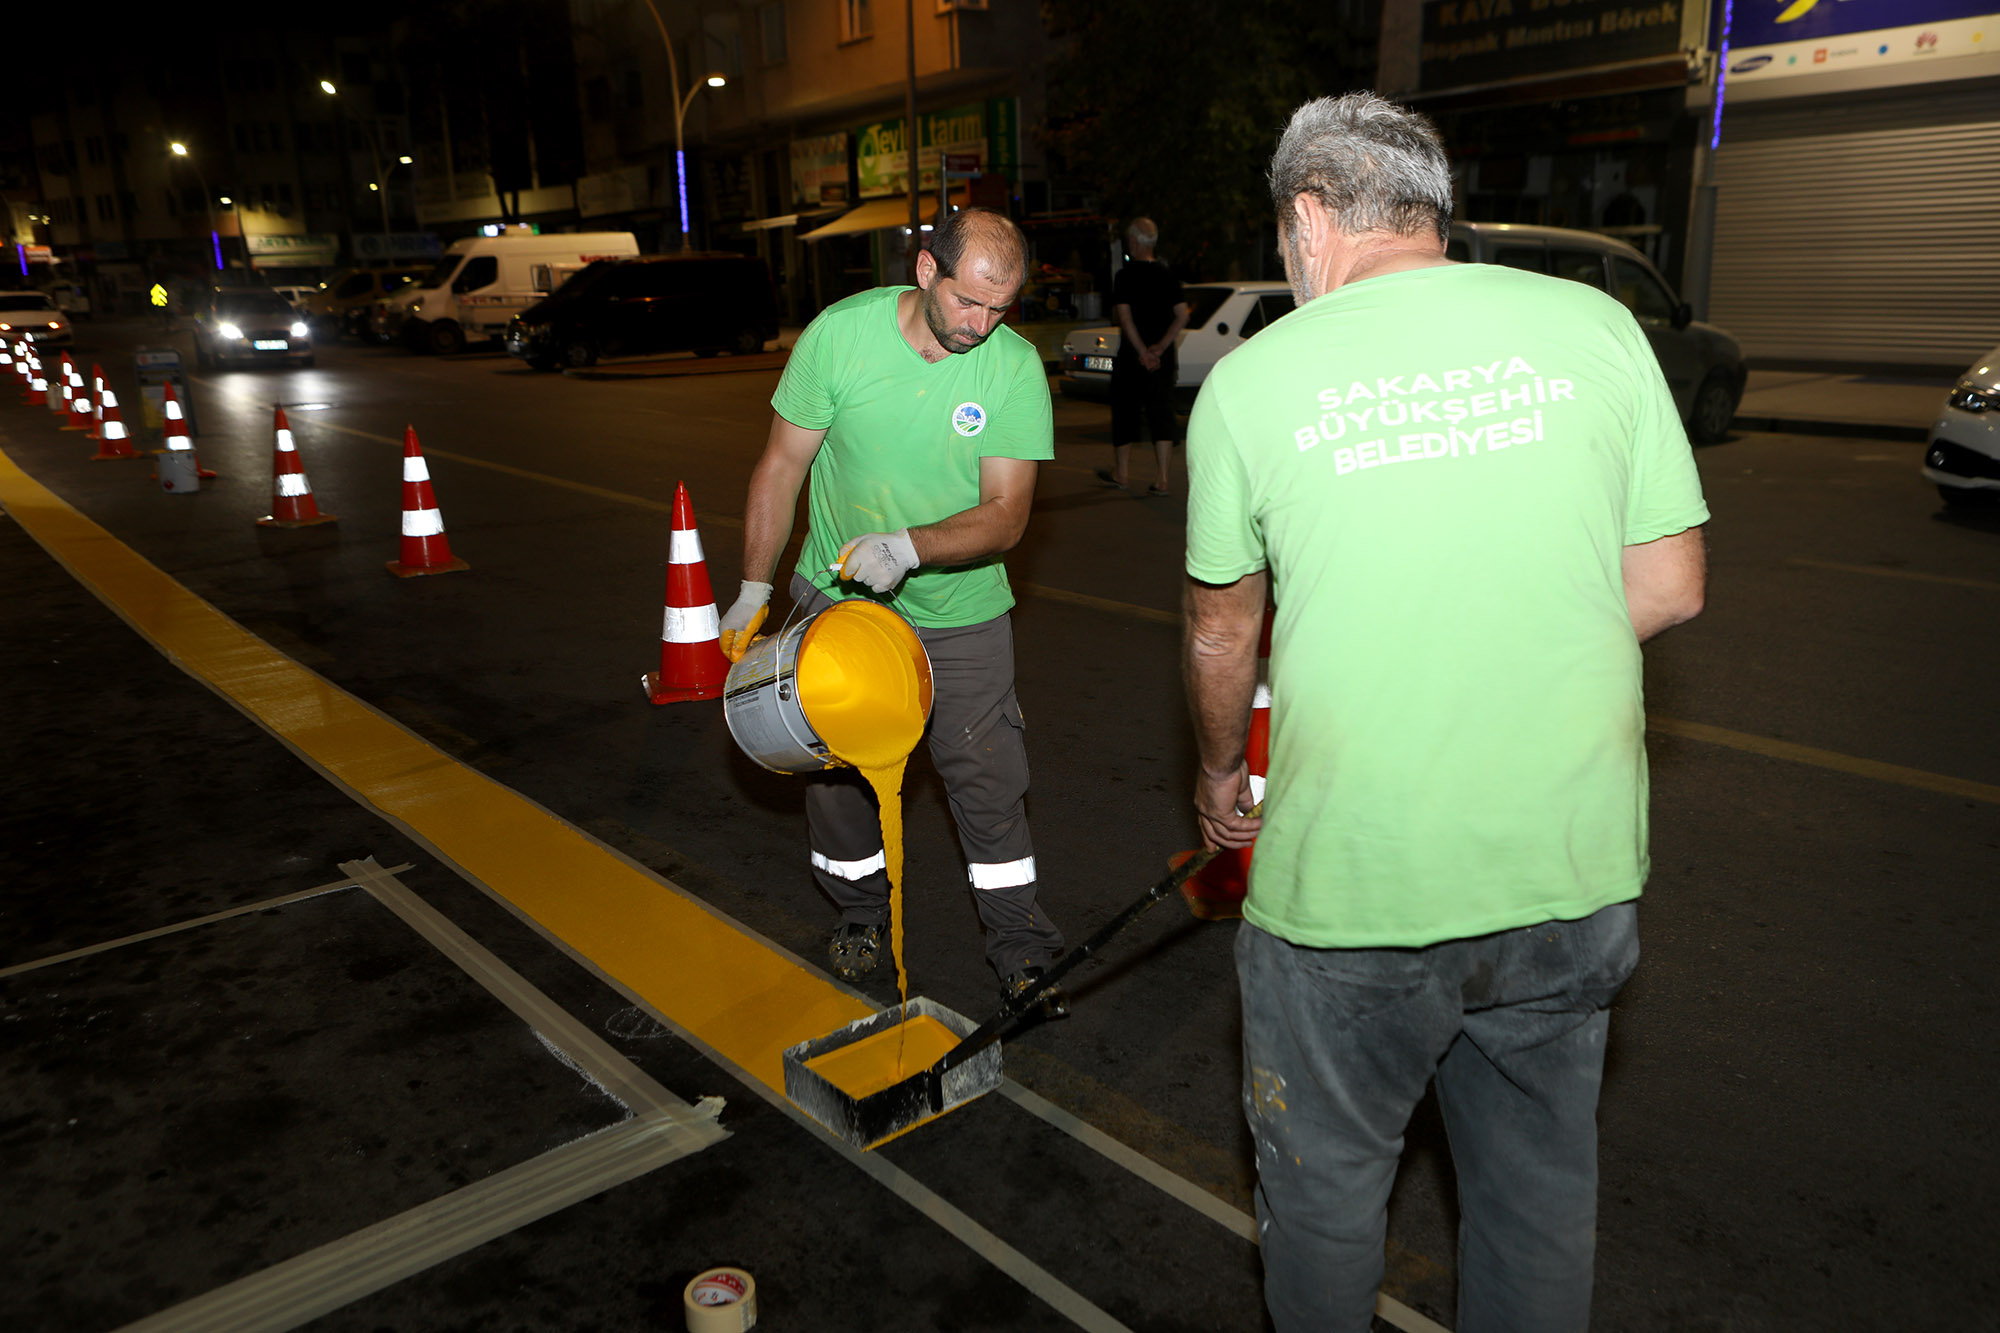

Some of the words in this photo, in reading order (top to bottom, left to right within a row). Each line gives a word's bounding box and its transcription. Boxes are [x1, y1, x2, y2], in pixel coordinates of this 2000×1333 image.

[1600, 2, 1678, 34] Börek
[1317, 356, 1536, 410] SAKARYA
[1294, 376, 1576, 452] BÜYÜKŞEHİR
[1333, 409, 1544, 476] BELEDİYESİ
